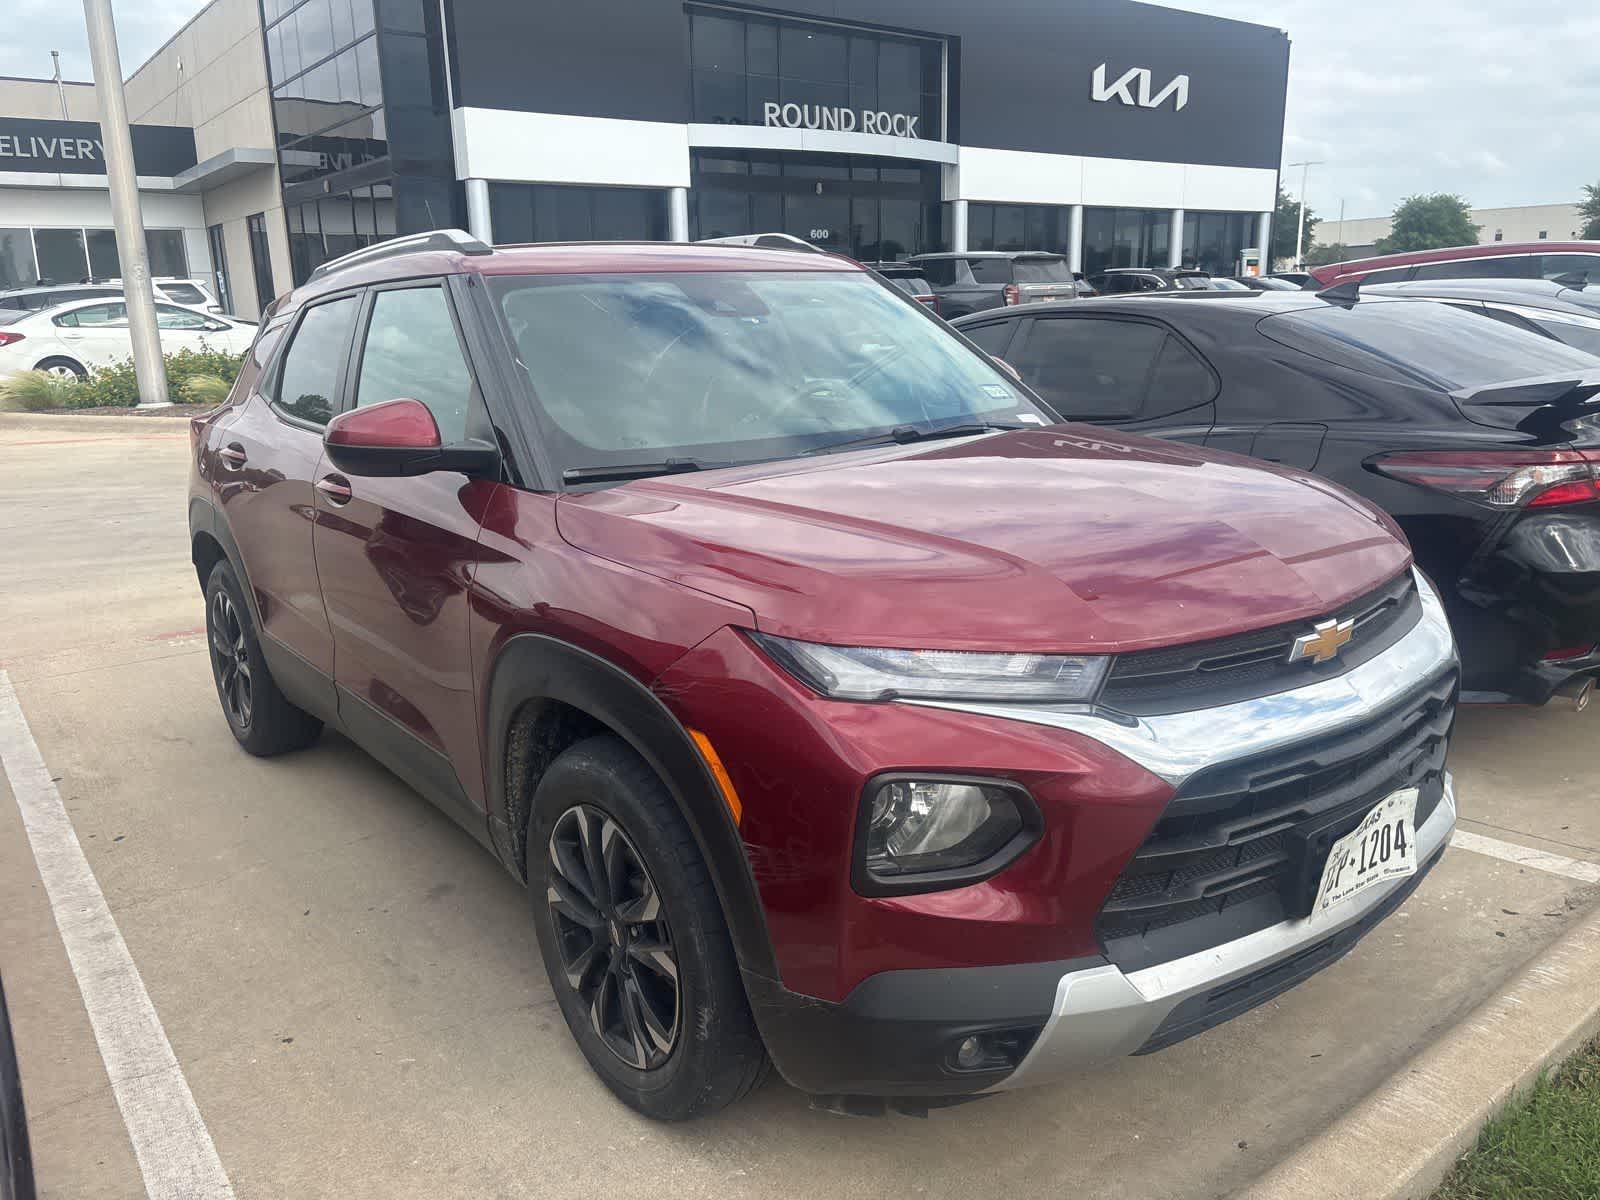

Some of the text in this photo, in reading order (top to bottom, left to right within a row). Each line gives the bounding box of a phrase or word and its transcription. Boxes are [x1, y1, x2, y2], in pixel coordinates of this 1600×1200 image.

[1092, 62, 1189, 111] KIA
[764, 102, 920, 139] ROUND ROCK
[810, 229, 829, 240] 600
[1358, 819, 1407, 875] 1204
